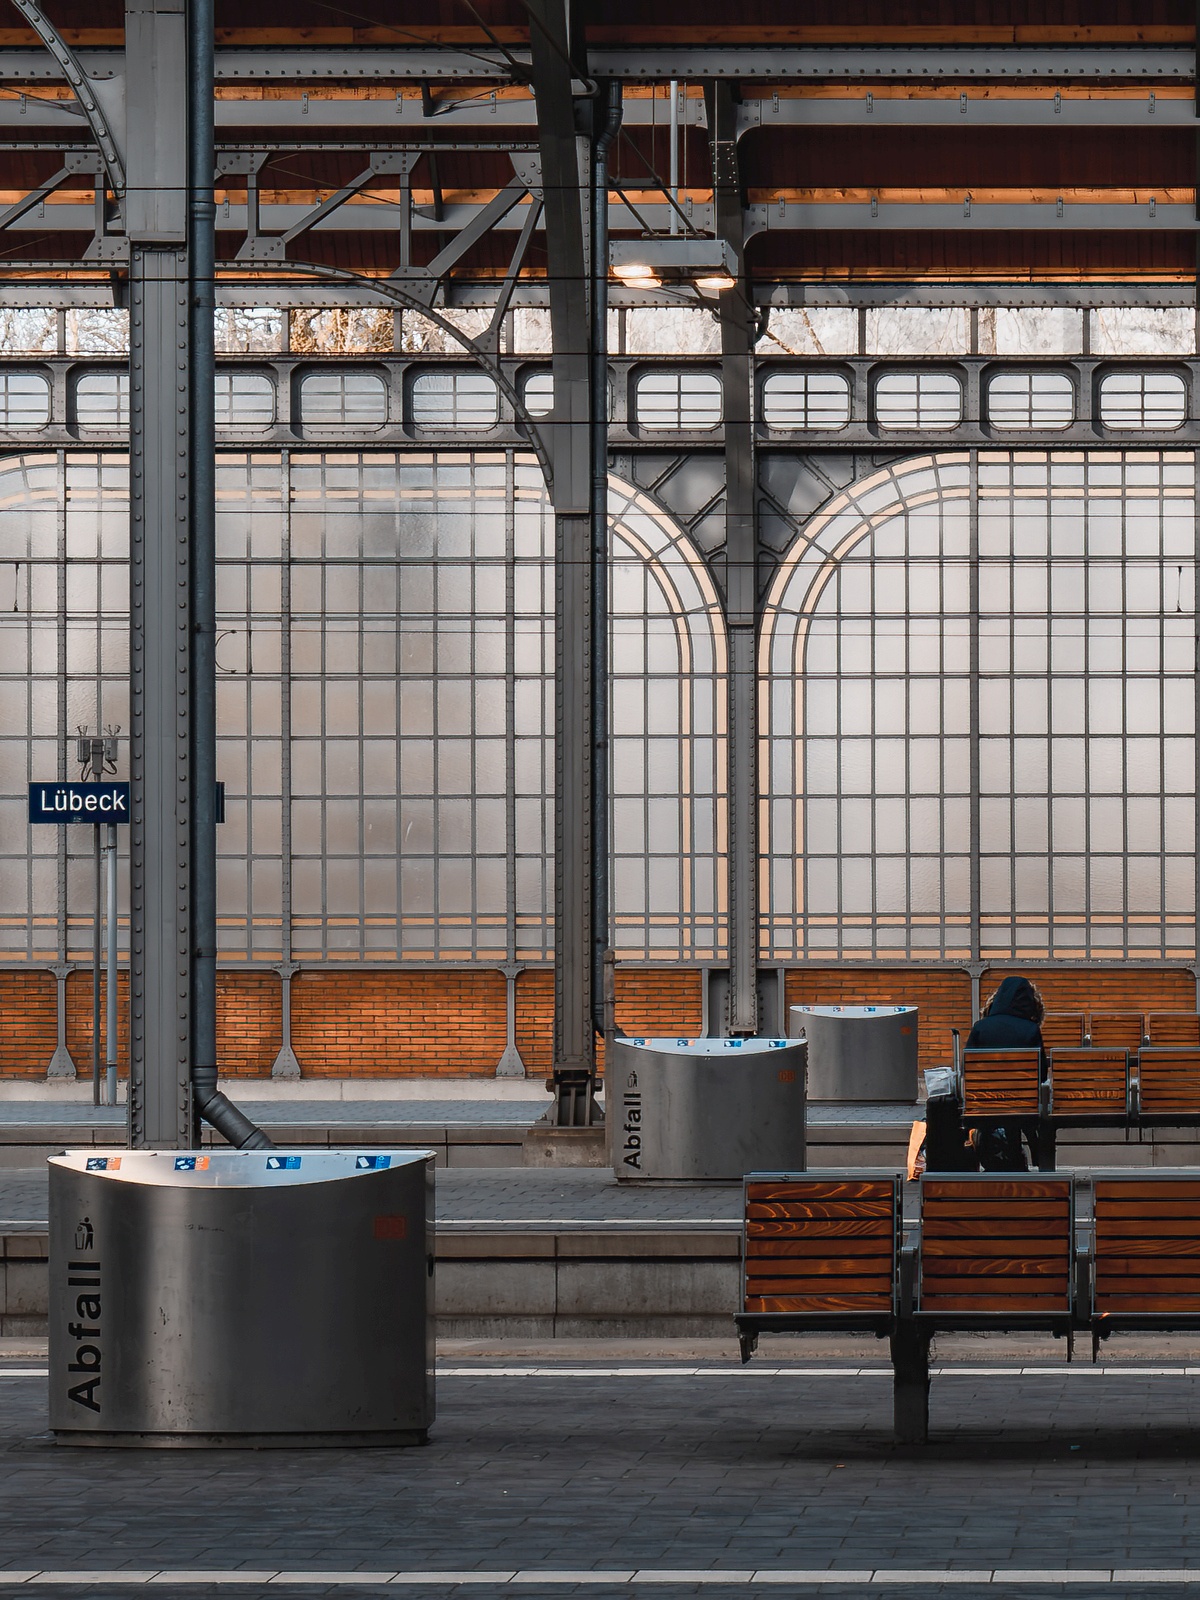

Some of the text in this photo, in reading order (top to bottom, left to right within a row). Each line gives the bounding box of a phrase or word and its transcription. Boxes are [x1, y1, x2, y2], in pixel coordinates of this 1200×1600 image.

[41, 789, 125, 811] Lübeck
[623, 1093, 642, 1170] Abfall
[67, 1261, 102, 1413] Abfall
